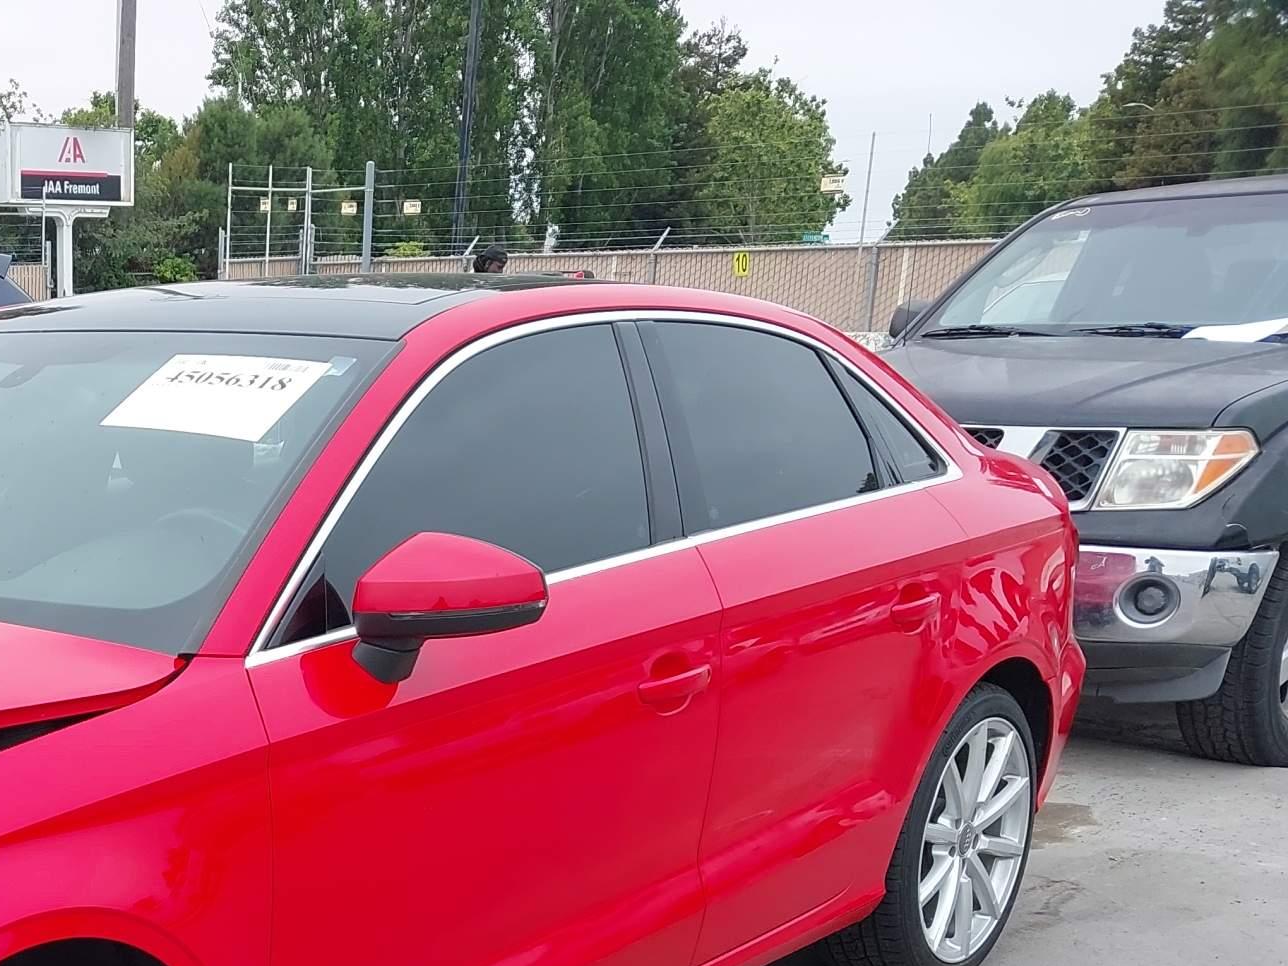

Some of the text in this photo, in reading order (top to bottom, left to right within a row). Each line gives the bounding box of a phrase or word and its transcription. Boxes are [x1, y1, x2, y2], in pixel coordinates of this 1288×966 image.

[44, 180, 100, 195] IAA Fremont
[736, 254, 748, 273] 10
[166, 369, 292, 391] 45056318
